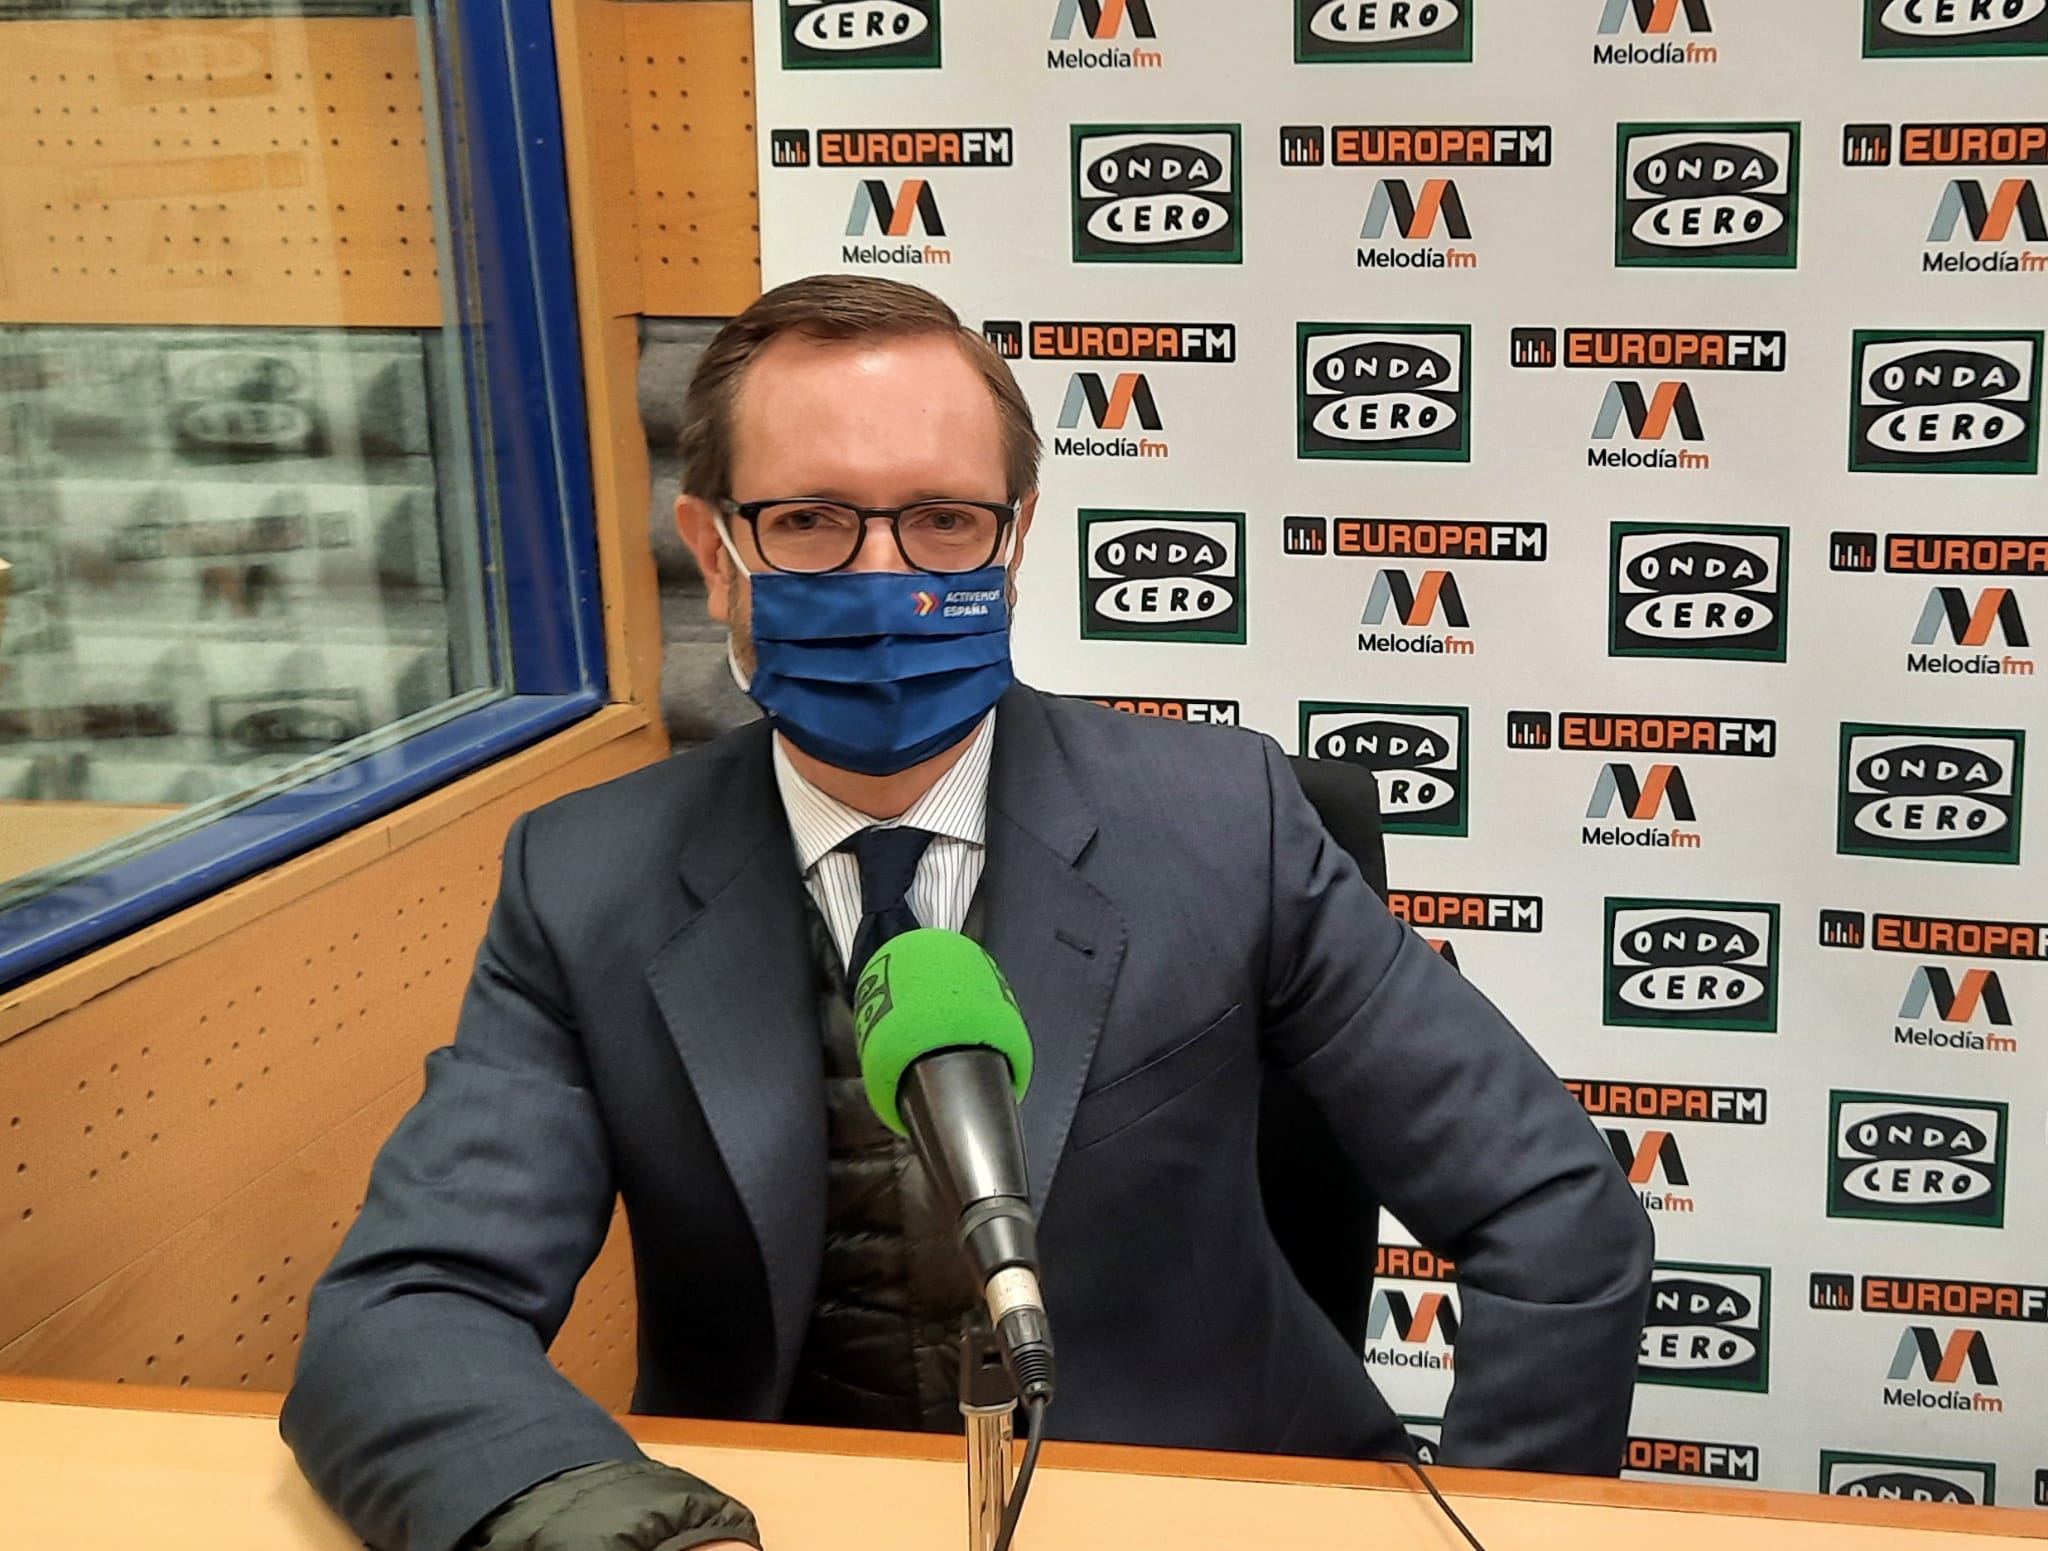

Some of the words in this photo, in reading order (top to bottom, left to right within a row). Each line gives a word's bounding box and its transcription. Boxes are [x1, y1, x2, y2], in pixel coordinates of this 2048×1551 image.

[812, 10, 910, 39] CERO
[1330, 2, 1439, 31] CERO
[1904, 0, 2024, 24] CERO
[1047, 49, 1162, 68] Melodíafm
[1594, 44, 1717, 64] Melodíafm
[821, 131, 1010, 164] EUROPAFM
[1337, 129, 1547, 163] EUROPAFM
[1100, 157, 1209, 183] ONDA
[1647, 157, 1765, 184] ONDA
[1106, 206, 1209, 232] CERO
[1653, 206, 1765, 235] CERO
[842, 246, 950, 264] Melodíafm
[1357, 248, 1477, 268] Melodíafm
[1033, 325, 1231, 358] EUROPAFM
[1569, 332, 1781, 366] EUROPAFM
[1326, 356, 1438, 381] ONDA
[1883, 365, 2007, 391] ONDA
[1332, 403, 1438, 430] CERO
[1888, 413, 2004, 441] CERO
[1055, 438, 1168, 458] Melodíafm
[1588, 448, 1709, 469] Melodíafm
[1338, 522, 1542, 557] EUROPAFM
[1107, 541, 1214, 565] ONDA
[1640, 555, 1754, 581] ONDA
[943, 604, 988, 617] ESPAÑA
[1114, 587, 1214, 613] CERO
[1645, 601, 1754, 629] CERO
[1358, 634, 1475, 655] Melodíafm
[1907, 654, 2034, 675] Melodíafm
[1328, 735, 1436, 758] ONDA
[1564, 717, 1771, 753] EUROPAFM
[1870, 759, 1989, 782] ONDA
[1390, 780, 1436, 805] RO
[1875, 803, 1986, 831] CERO
[1582, 826, 1700, 848] Melodíafm
[1388, 893, 1538, 929] ROPAFM
[1634, 931, 1746, 955] ONDA
[1640, 975, 1746, 1000] CERO
[1895, 1027, 2016, 1053] Melodíafm
[1858, 1125, 1972, 1150] ONDA
[1864, 1168, 1972, 1194] CERO
[1656, 1291, 1738, 1316] NDA
[1884, 1387, 2002, 1413] Melodíafm
[1628, 1441, 1754, 1478] OPAFM
